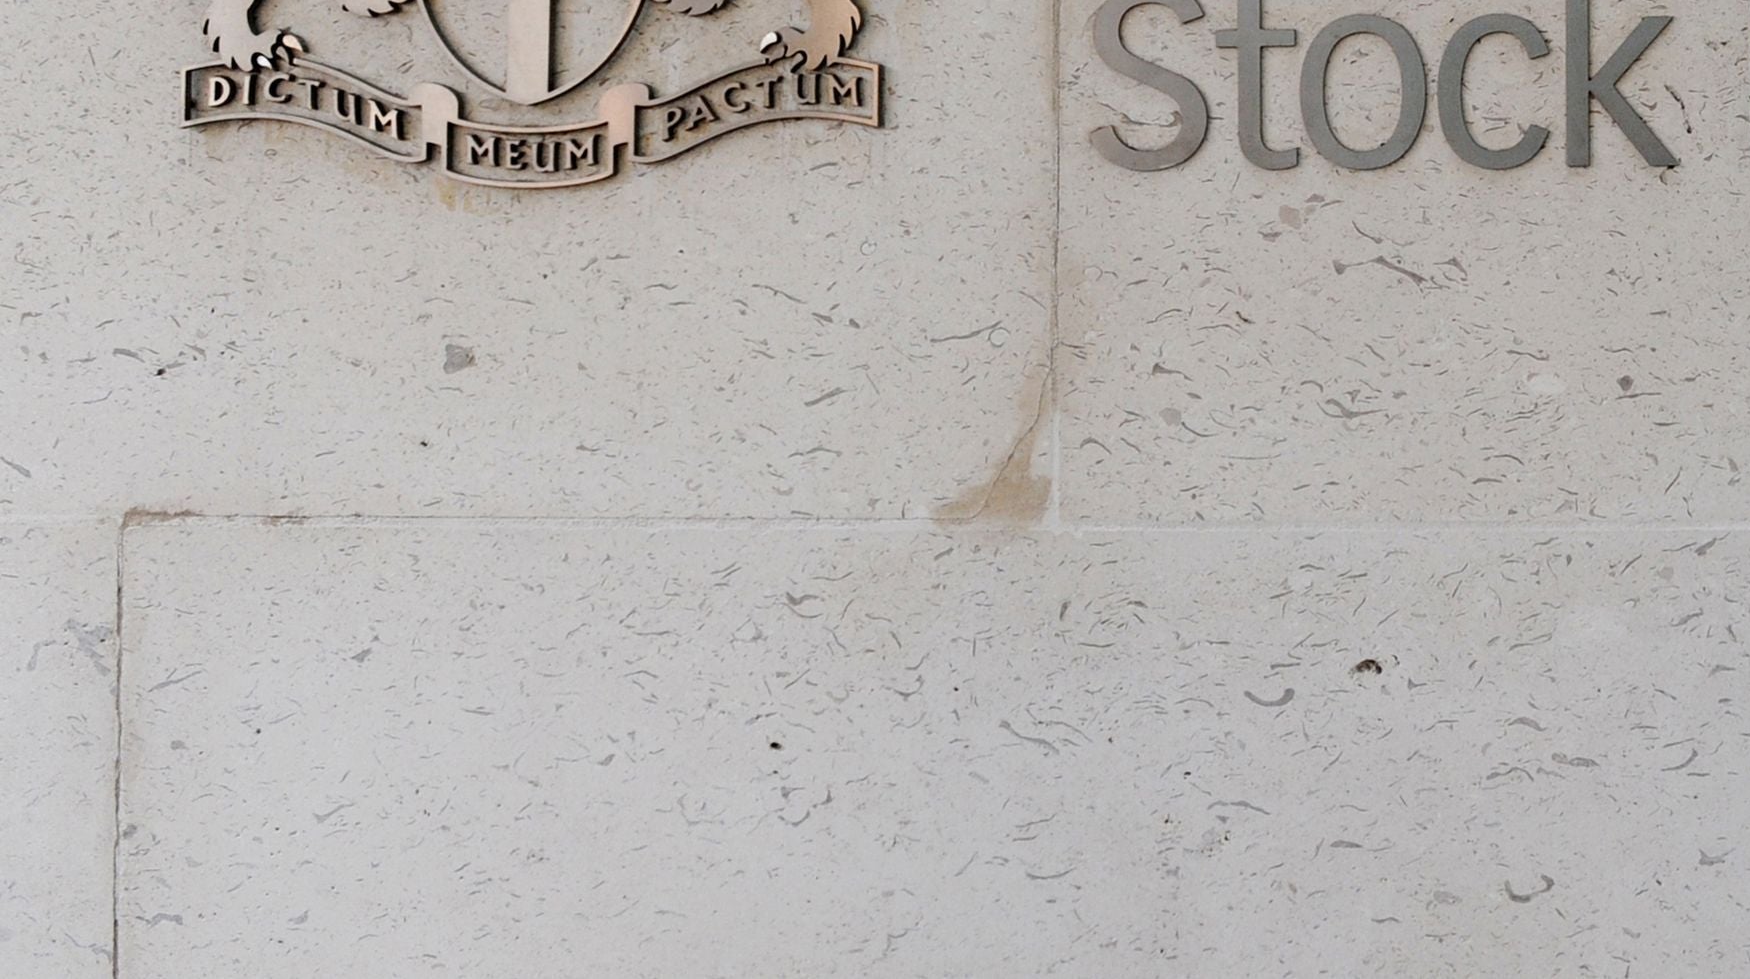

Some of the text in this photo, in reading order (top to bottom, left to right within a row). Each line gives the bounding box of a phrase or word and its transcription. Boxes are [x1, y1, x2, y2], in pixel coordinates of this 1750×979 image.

[207, 71, 864, 174] DICTUM MEUM PACTUM
